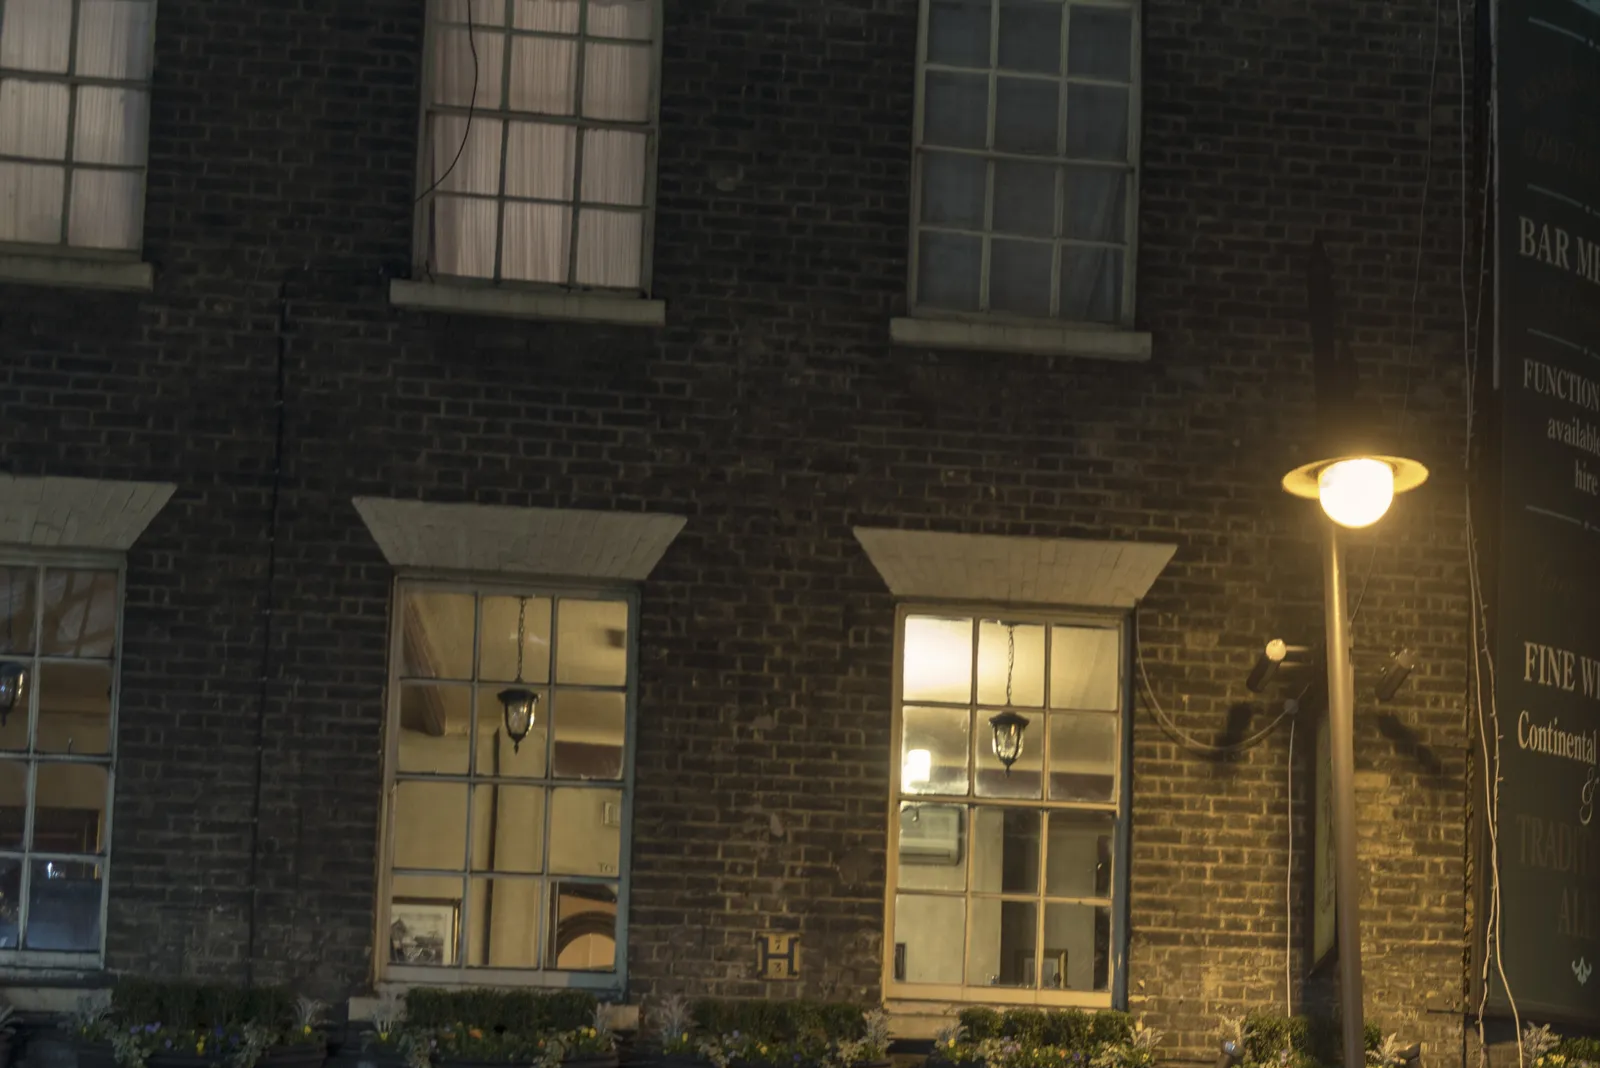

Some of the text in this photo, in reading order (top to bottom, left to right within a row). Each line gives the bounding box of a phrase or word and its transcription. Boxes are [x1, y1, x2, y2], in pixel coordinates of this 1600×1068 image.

[1518, 215, 1571, 271] BAR
[1523, 358, 1599, 413] FUNCTION
[1574, 459, 1600, 496] hire
[1523, 641, 1576, 692] FINE
[1517, 710, 1597, 765] Continental
